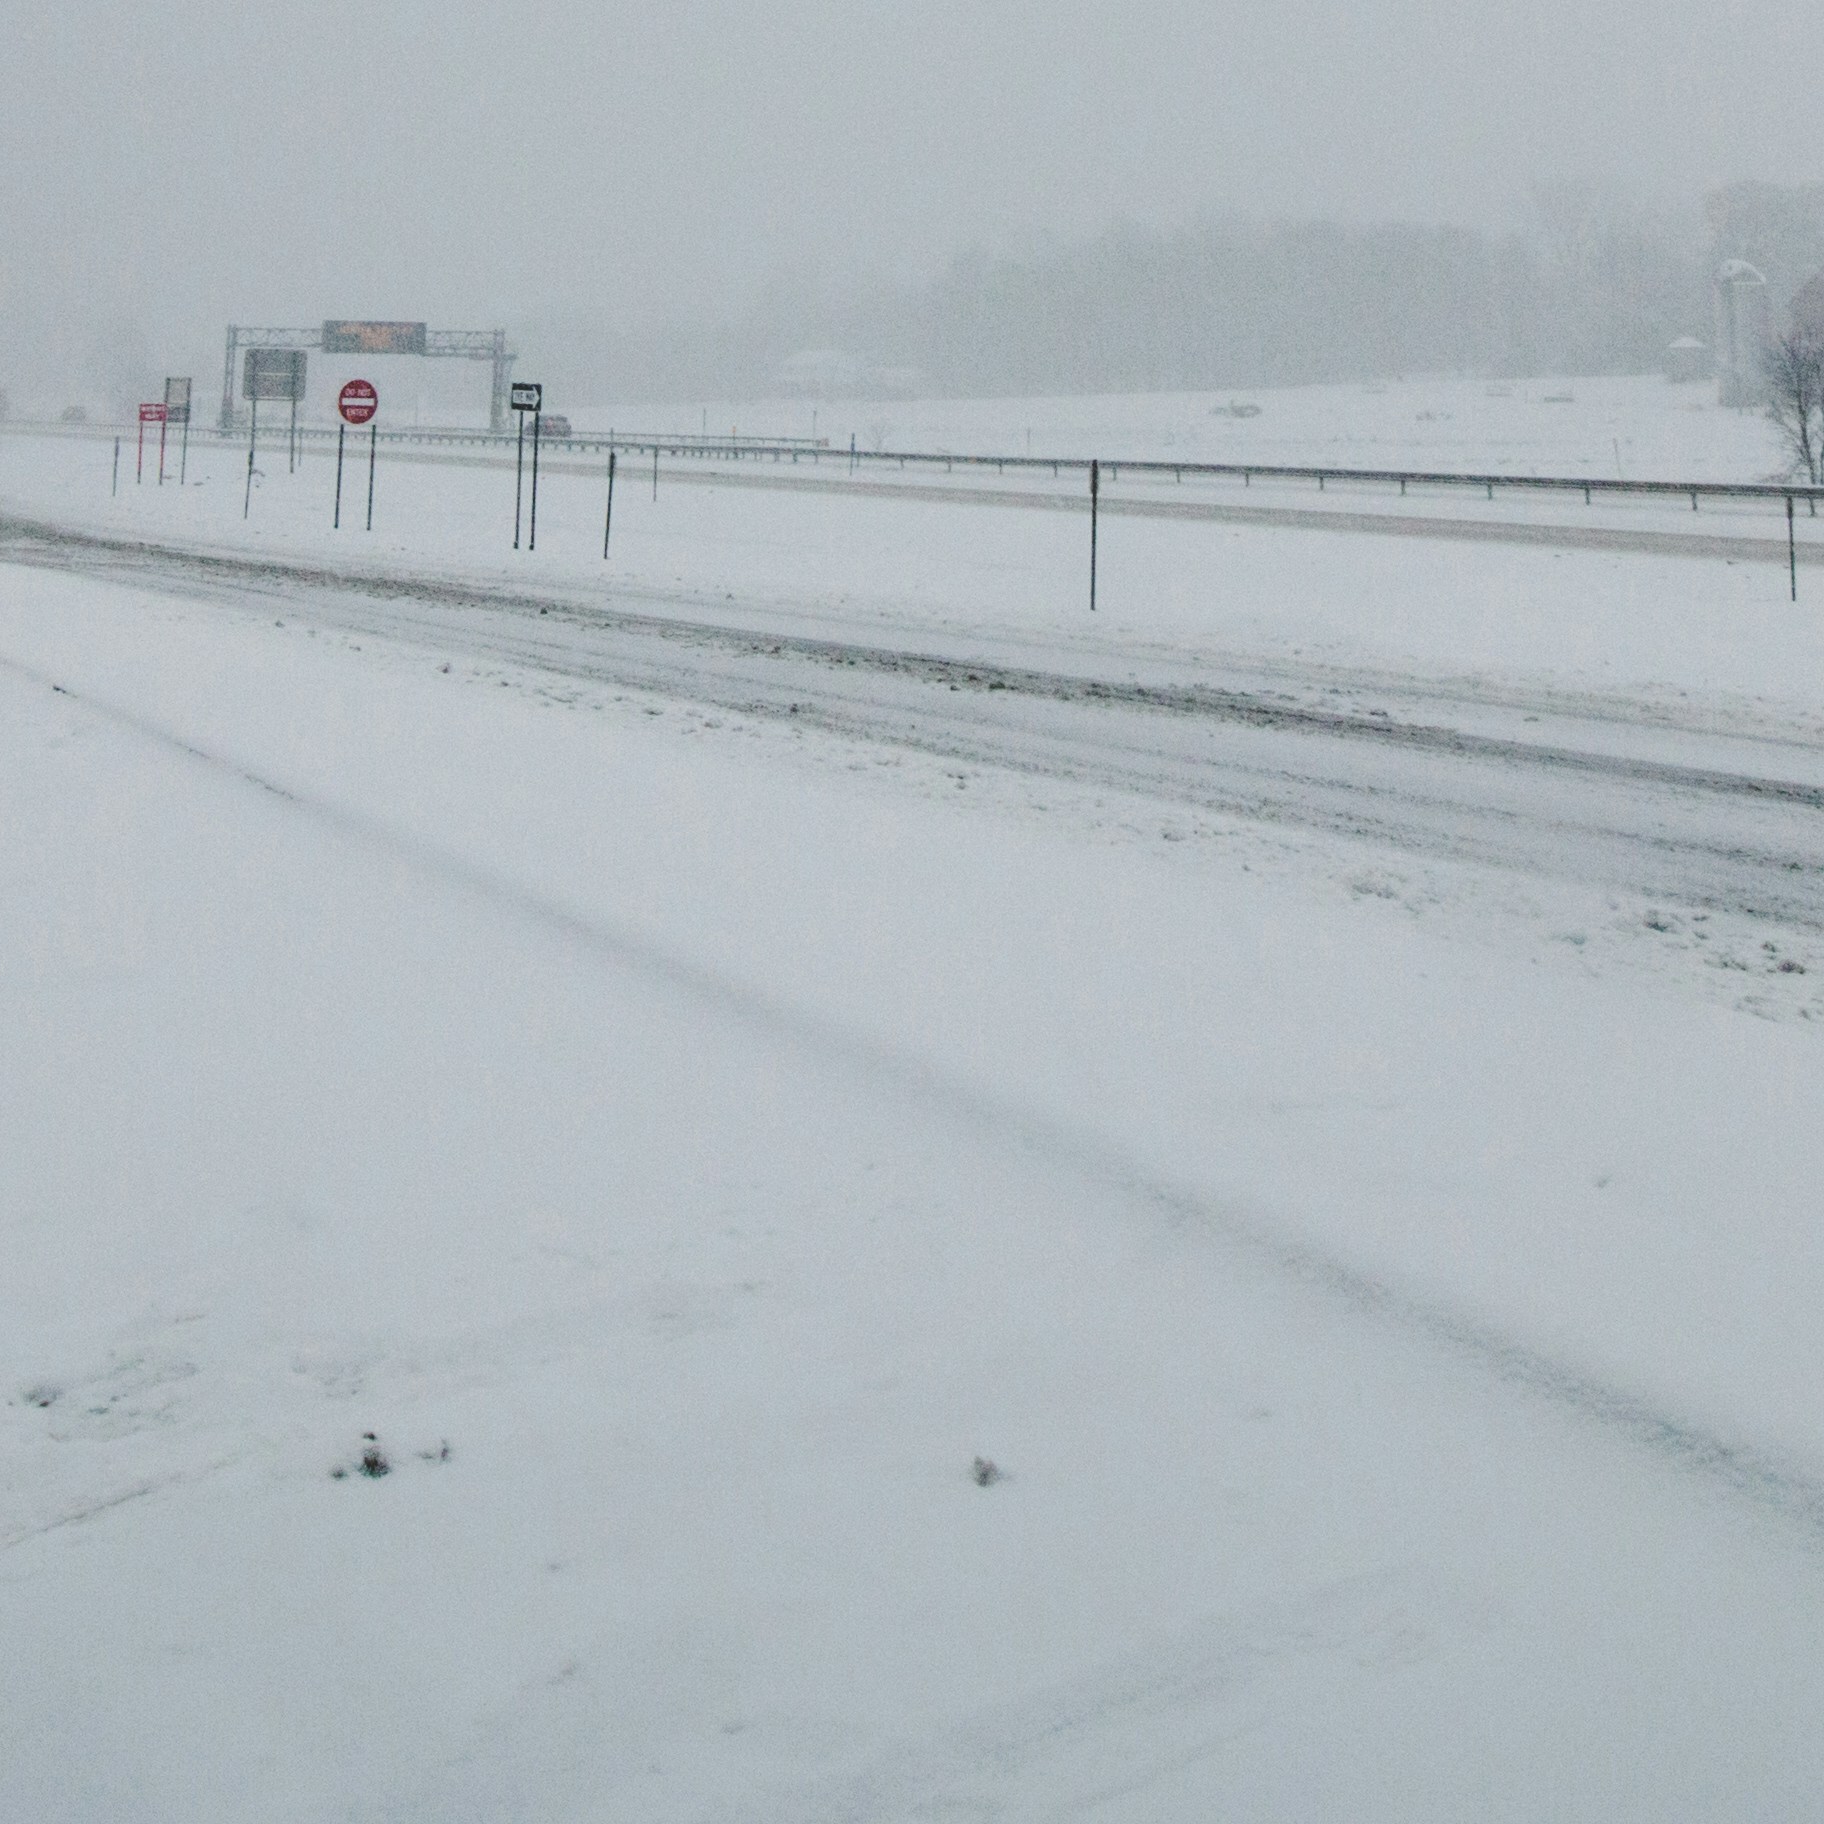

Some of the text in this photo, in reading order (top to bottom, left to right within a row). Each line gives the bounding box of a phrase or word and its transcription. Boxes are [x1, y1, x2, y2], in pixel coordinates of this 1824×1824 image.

[345, 388, 371, 396] DO NOT
[346, 408, 368, 416] ENTER
